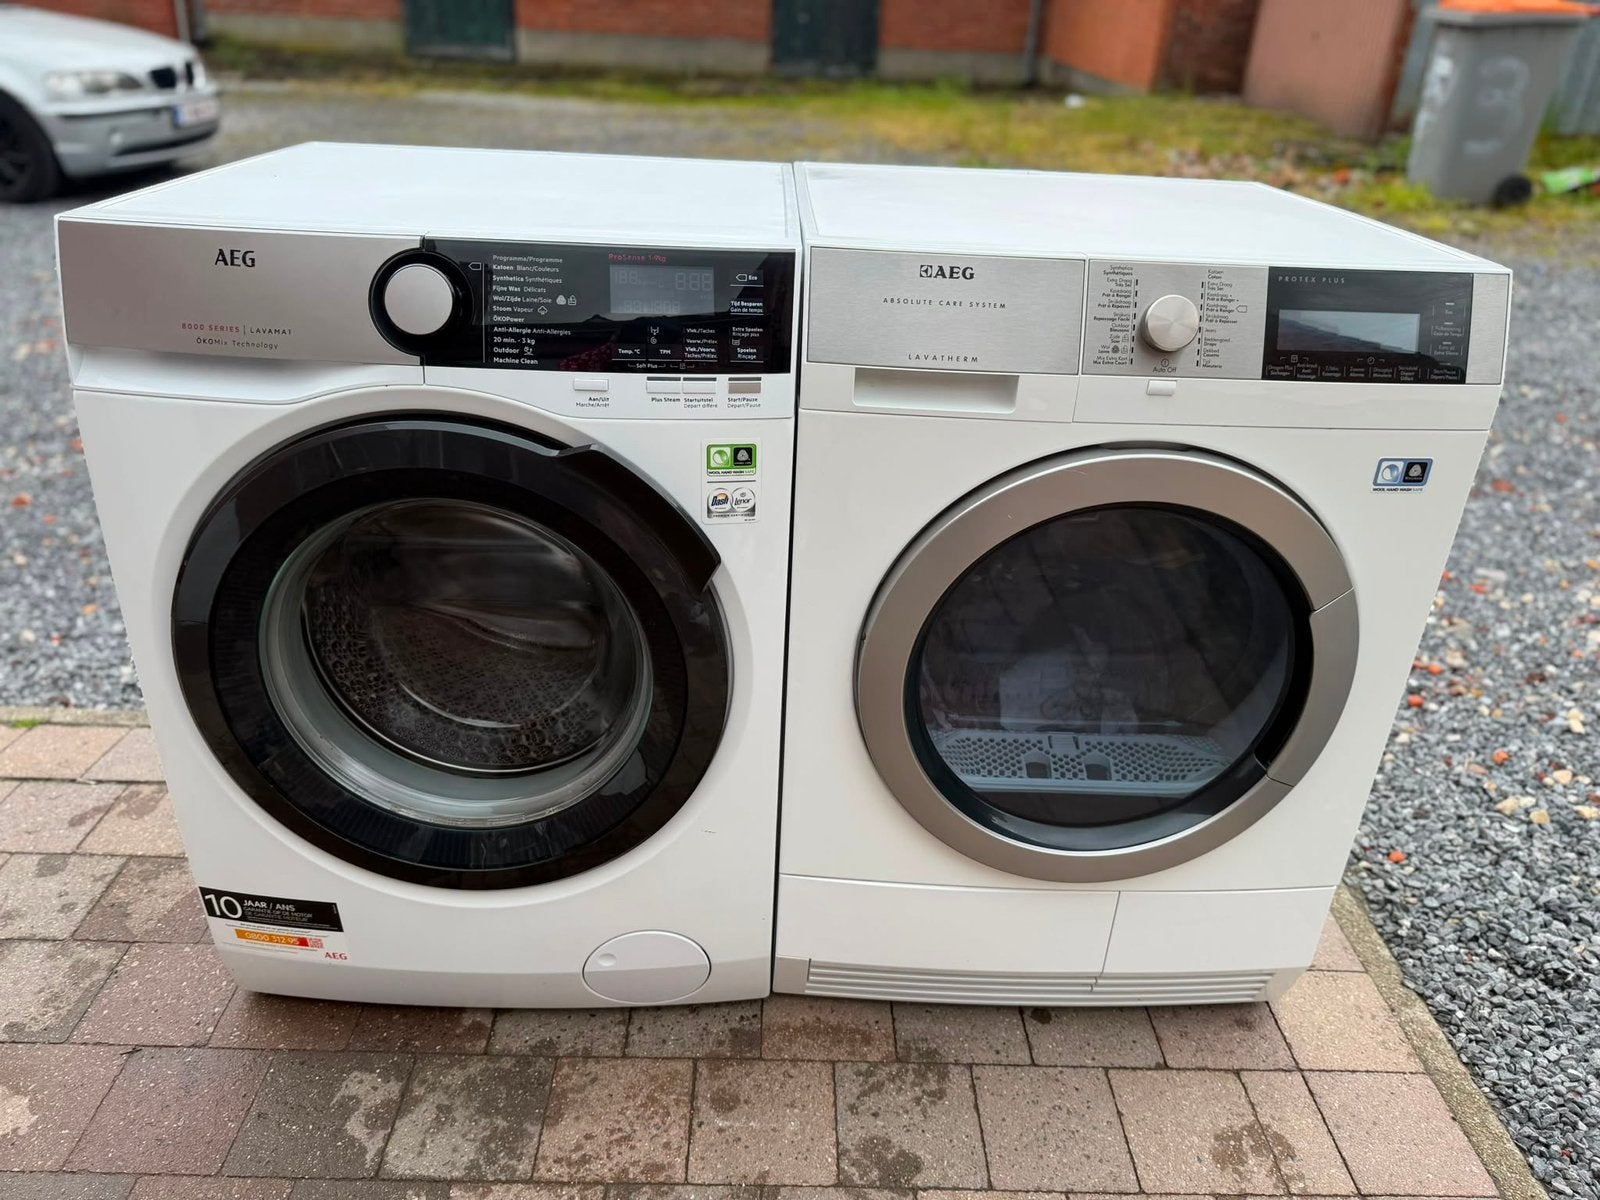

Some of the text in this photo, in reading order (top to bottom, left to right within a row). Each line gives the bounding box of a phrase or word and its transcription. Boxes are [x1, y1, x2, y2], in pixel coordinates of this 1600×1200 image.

[214, 248, 256, 268] AEG
[493, 254, 562, 263] Programma/Programme
[516, 265, 559, 273] Blanc/Couleurs
[934, 266, 974, 280] AEG
[883, 298, 932, 306] ABSOLUTE
[208, 324, 240, 332] SERIES
[232, 340, 278, 350] Technology
[908, 354, 978, 362] LAVATHERM
[711, 496, 752, 506] Dash Lenor
[204, 894, 242, 918] 10
[243, 900, 268, 908] JAAR
[276, 904, 296, 912] ANS
[244, 932, 300, 945] 0800 312 95
[325, 952, 348, 960] AEG
